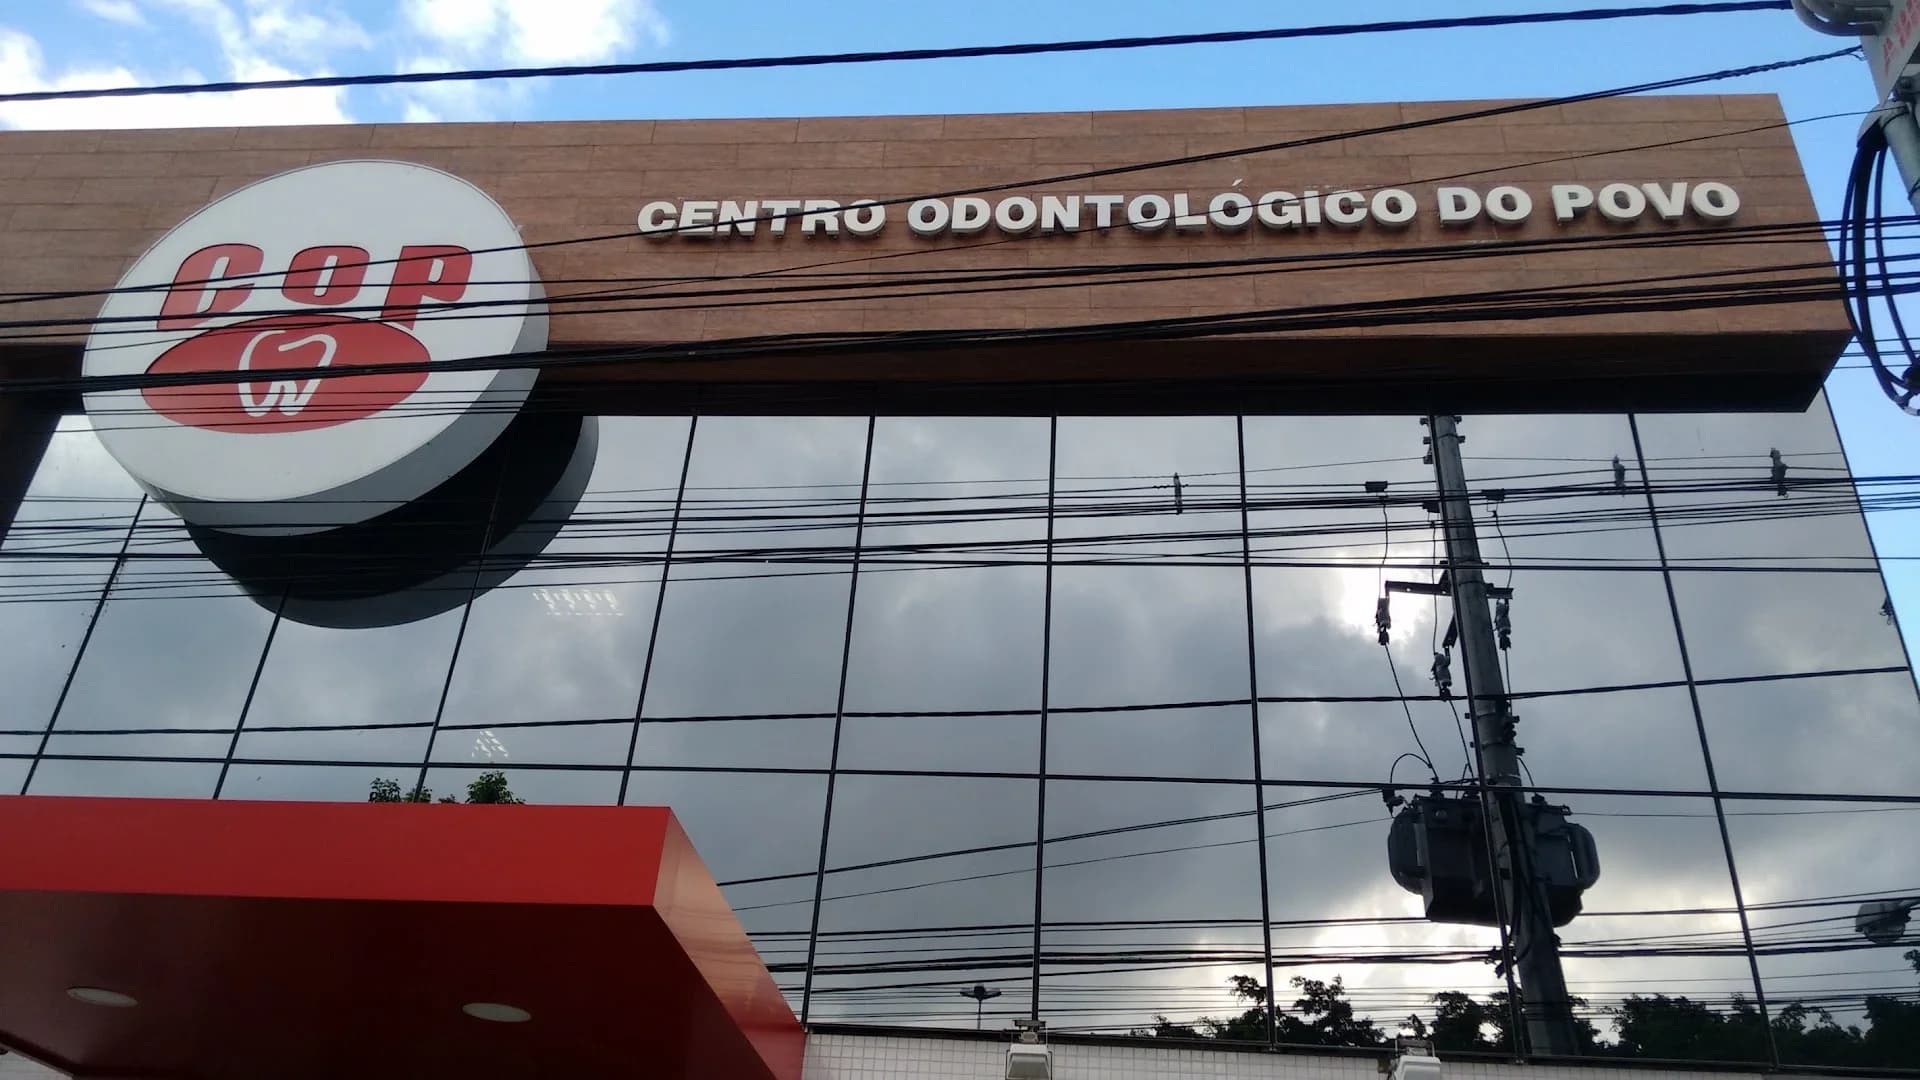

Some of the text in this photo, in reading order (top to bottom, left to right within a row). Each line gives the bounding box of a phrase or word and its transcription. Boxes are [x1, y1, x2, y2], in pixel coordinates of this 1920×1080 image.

[637, 178, 1740, 236] CENTRO ODONTOLÓGICO DO POVO
[157, 243, 473, 331] COP
